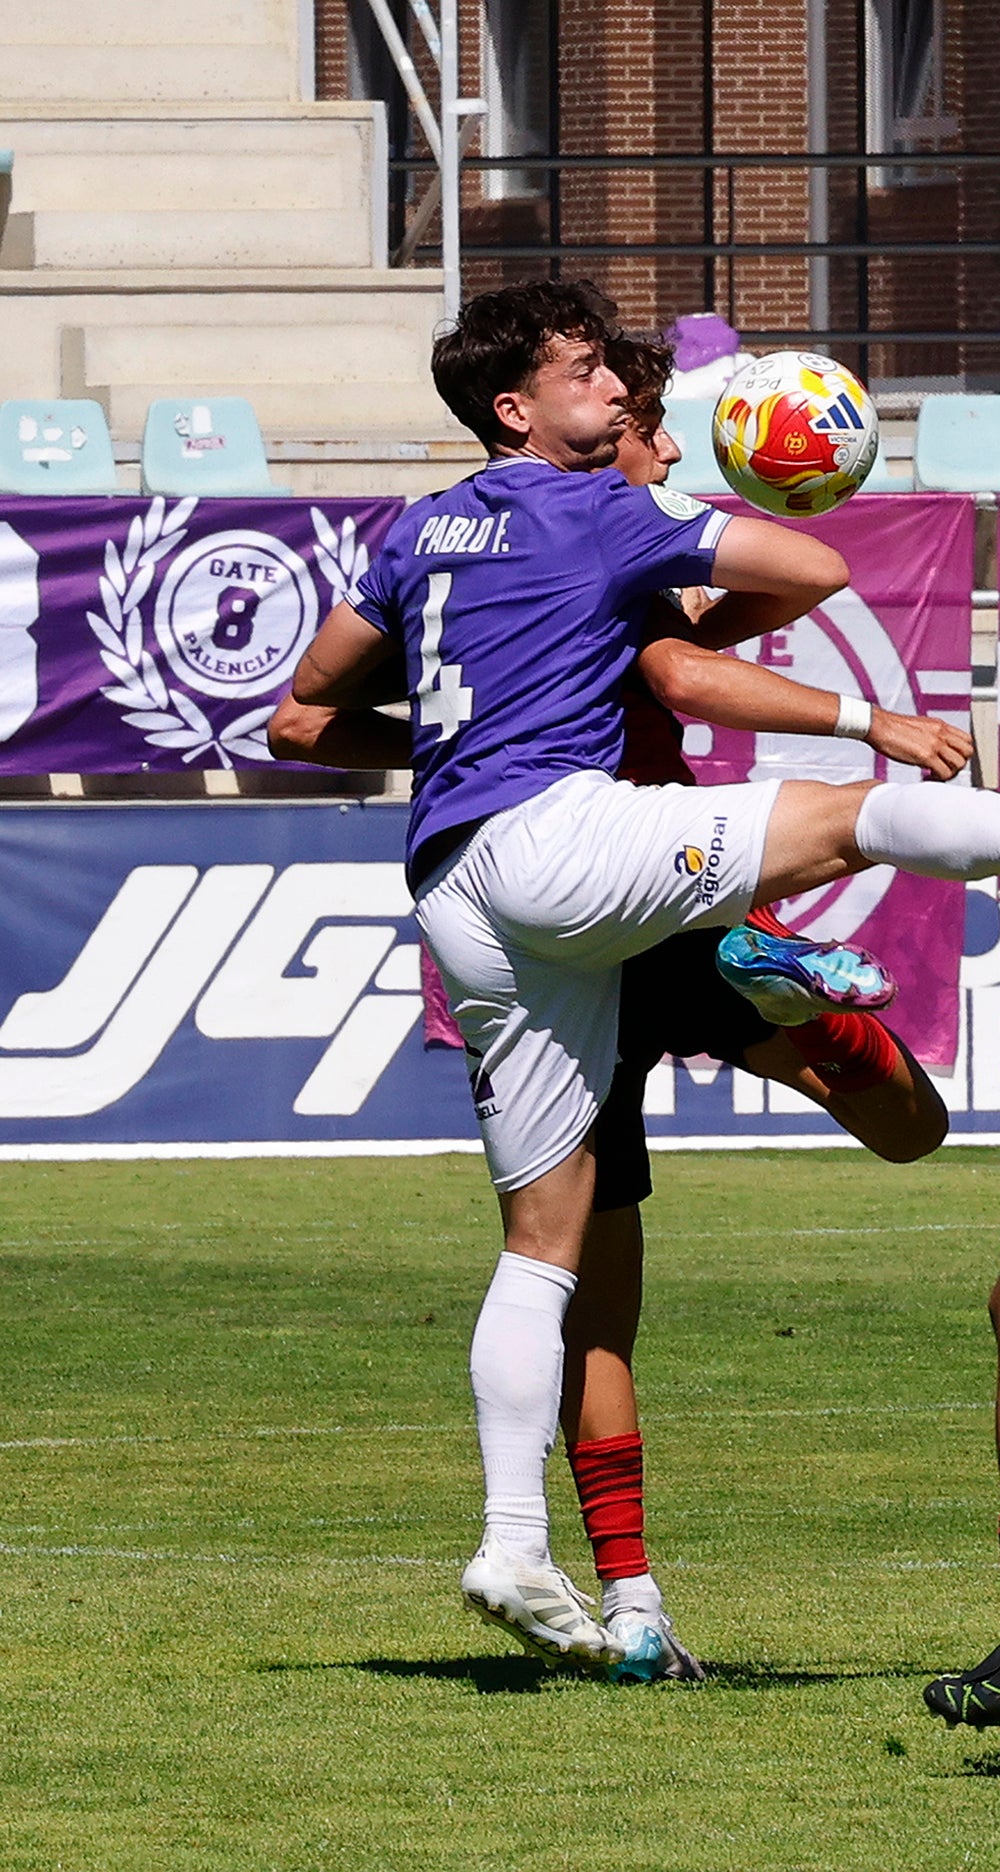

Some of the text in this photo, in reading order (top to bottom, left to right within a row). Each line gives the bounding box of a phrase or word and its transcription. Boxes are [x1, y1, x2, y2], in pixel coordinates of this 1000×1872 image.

[414, 511, 511, 555] PABLO F.
[209, 557, 279, 584] GATE
[212, 586, 262, 651] 8
[183, 629, 282, 676] PALENCIA
[416, 572, 474, 742] 4
[701, 816, 728, 906] agropal
